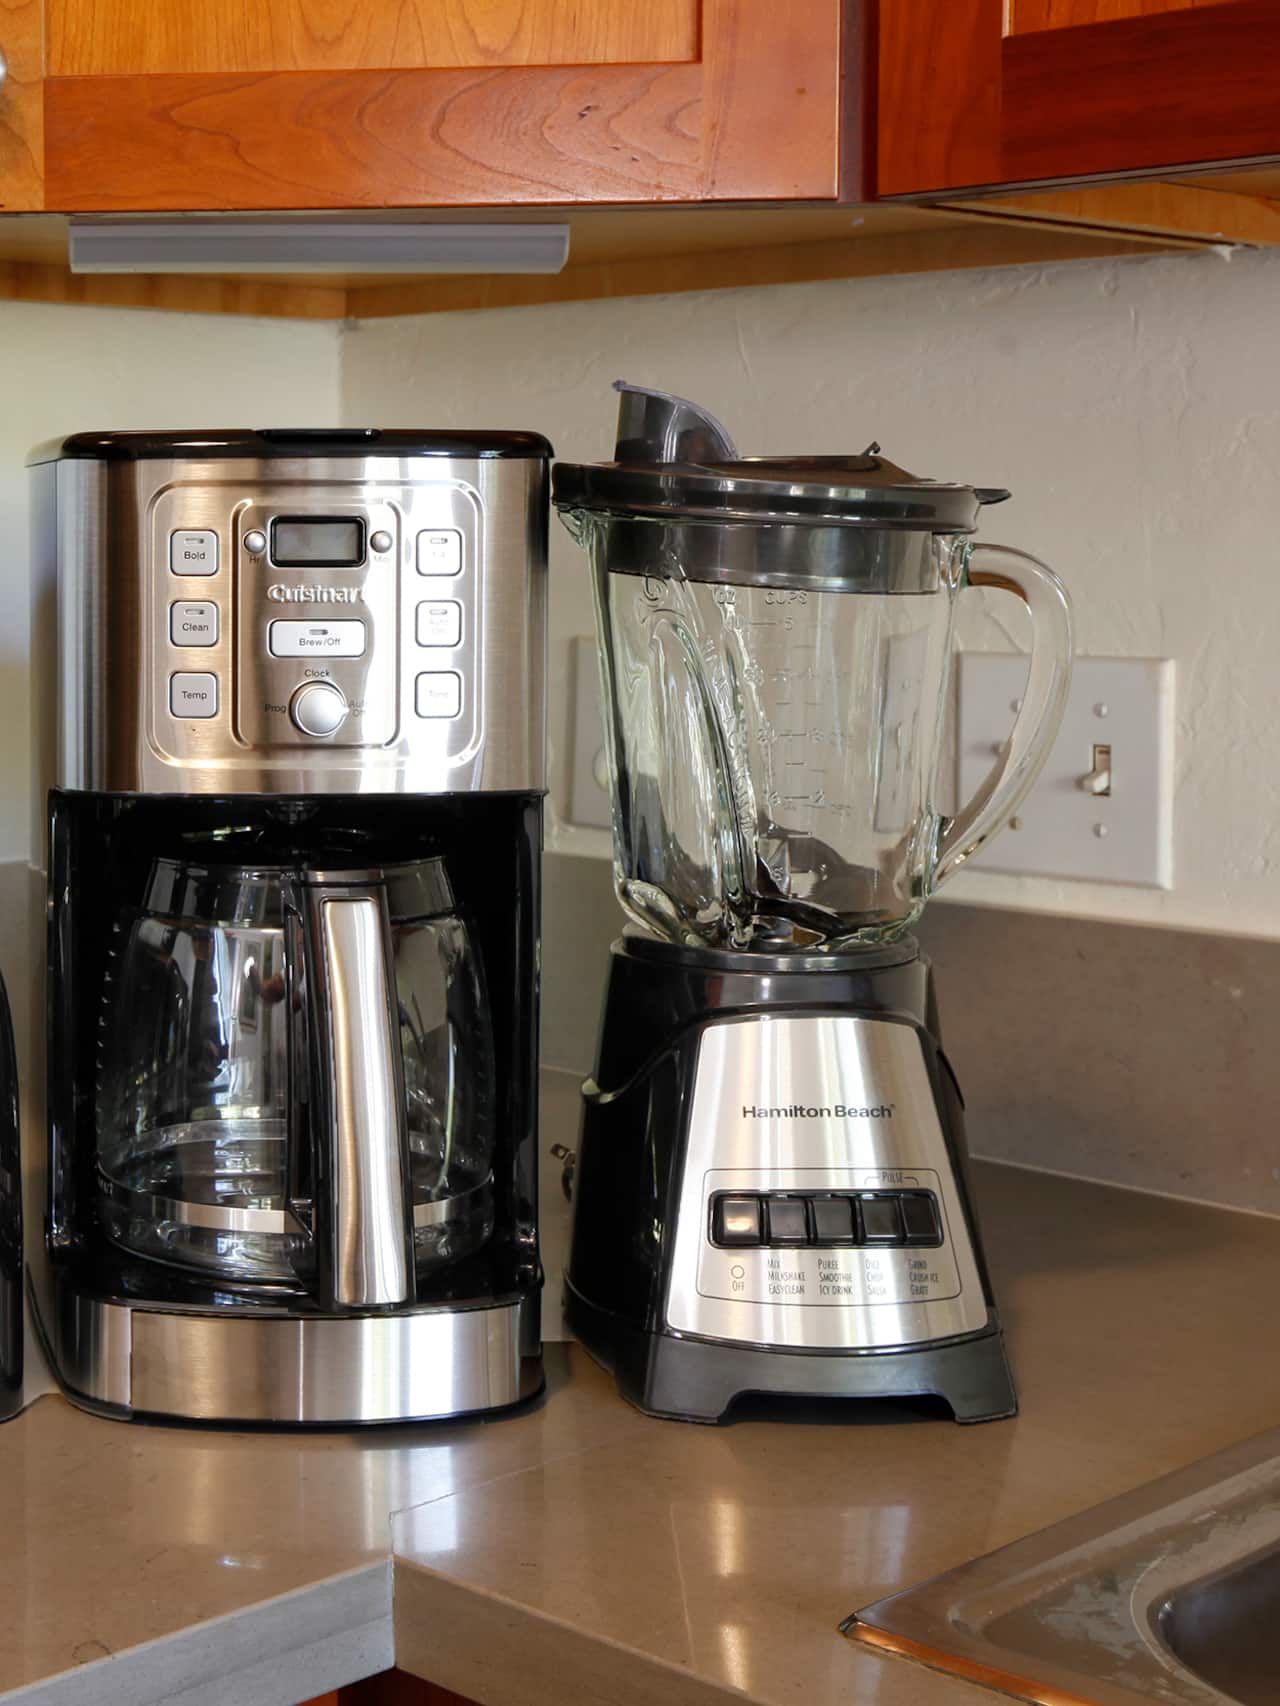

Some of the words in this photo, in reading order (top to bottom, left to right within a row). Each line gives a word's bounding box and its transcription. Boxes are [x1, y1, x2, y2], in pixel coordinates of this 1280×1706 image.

[183, 550, 206, 561] Bold
[182, 622, 209, 632] Clean
[304, 668, 330, 678] Clock
[181, 690, 208, 701] Temp
[264, 703, 287, 714] Prog
[742, 1104, 831, 1119] Hamilton
[835, 1104, 892, 1119] Beach
